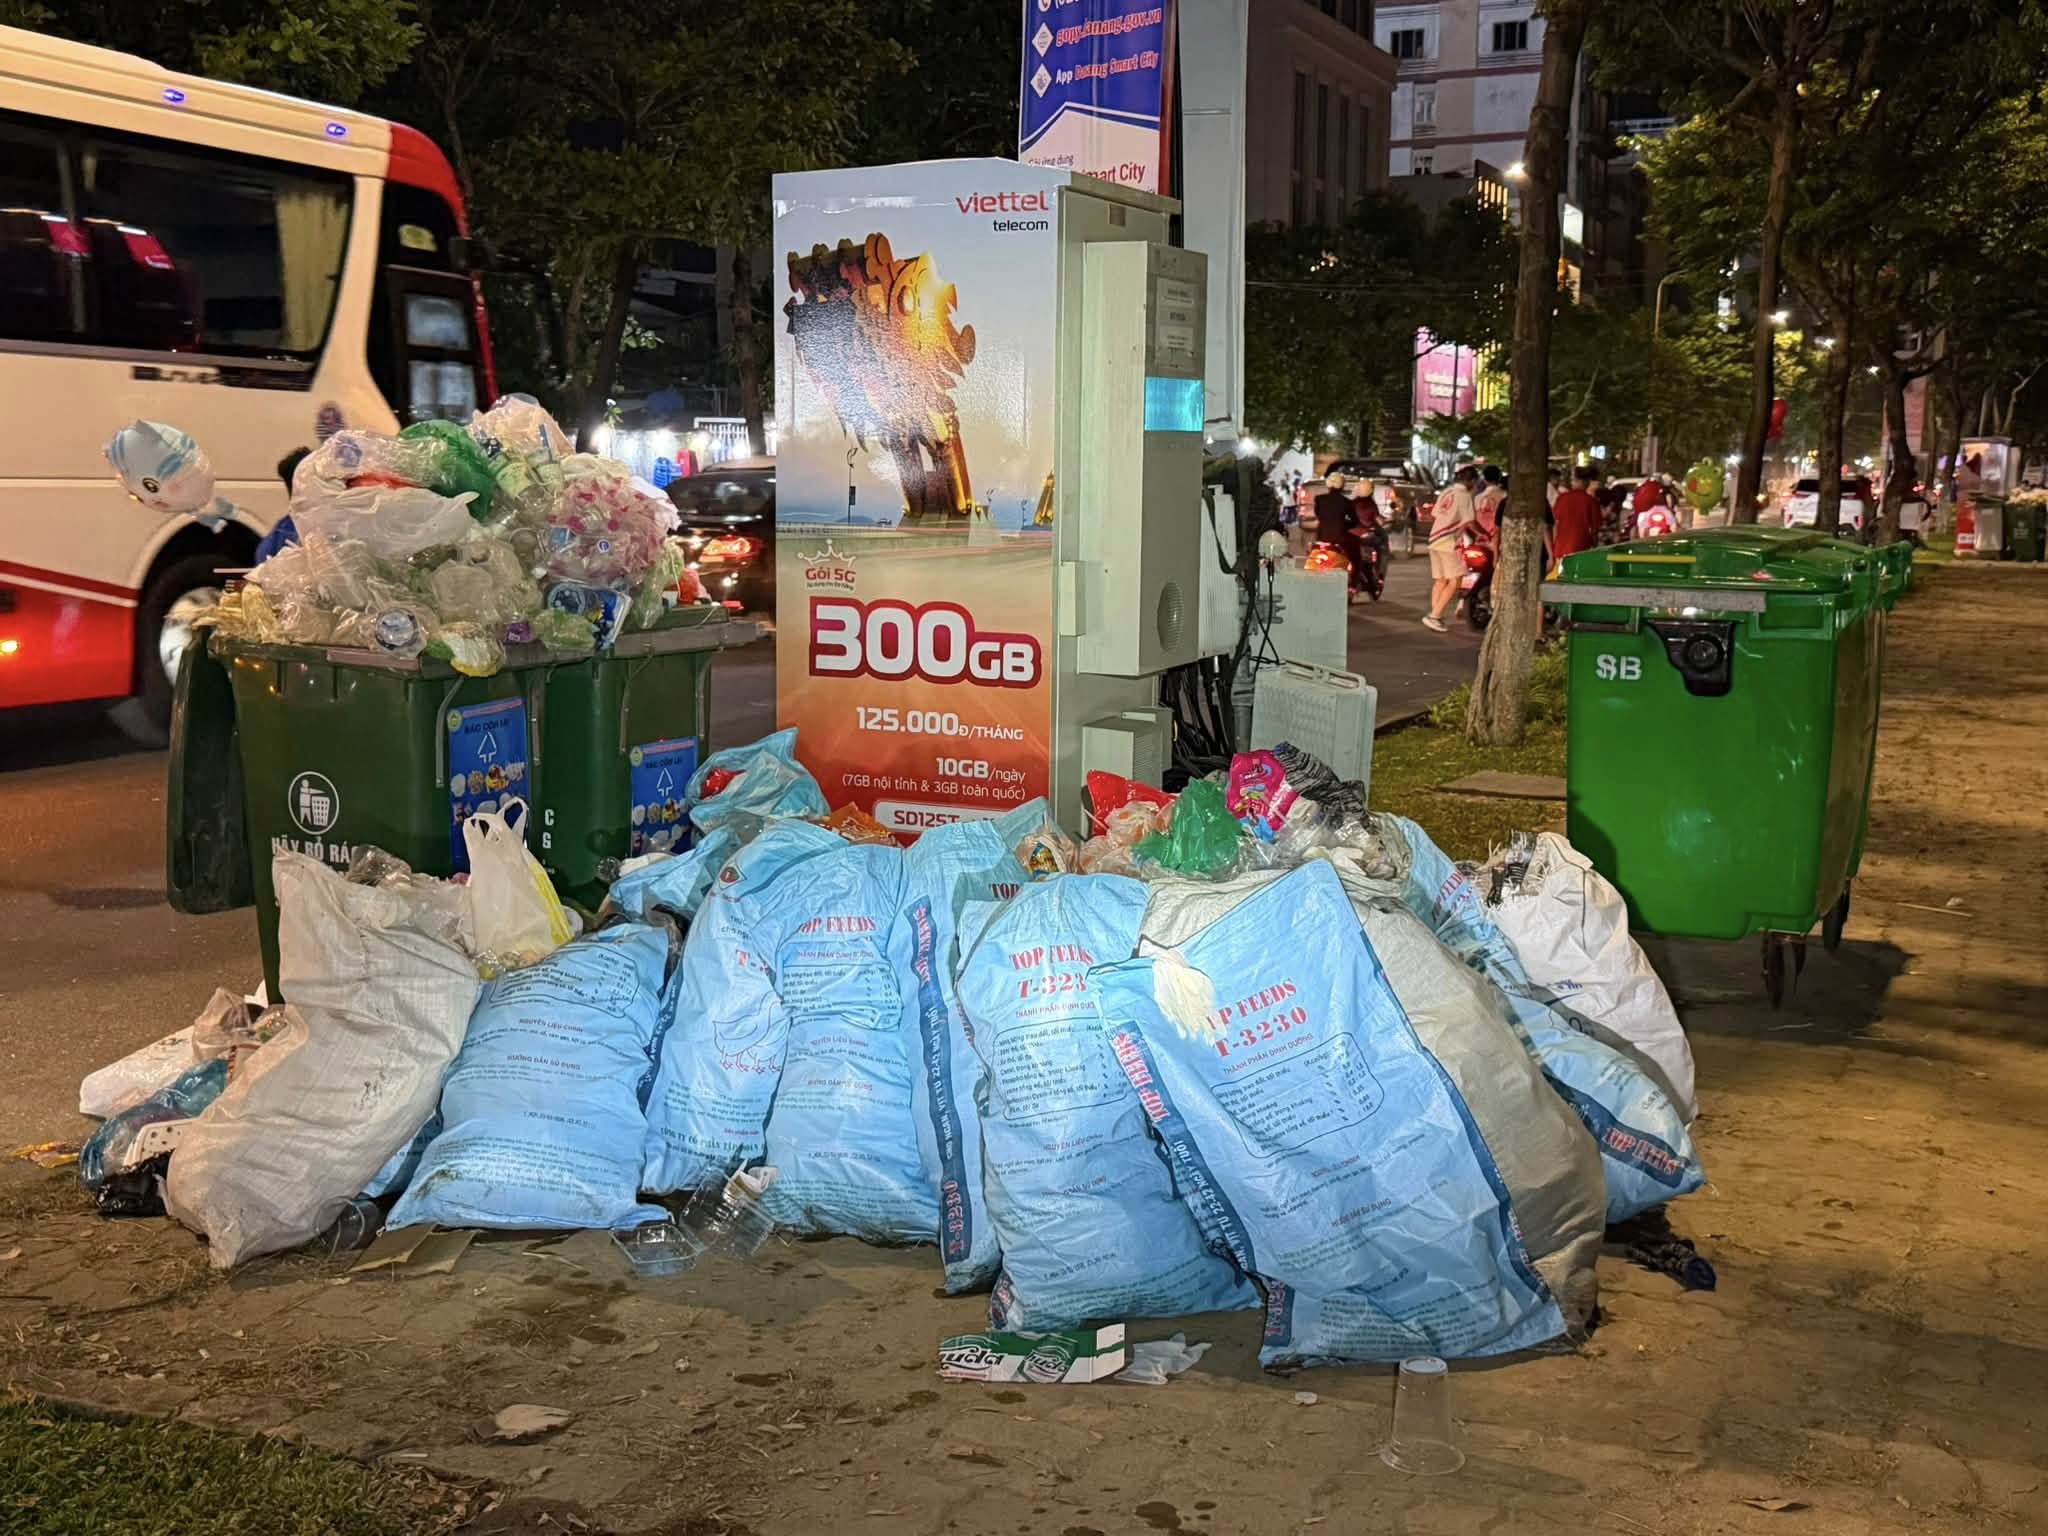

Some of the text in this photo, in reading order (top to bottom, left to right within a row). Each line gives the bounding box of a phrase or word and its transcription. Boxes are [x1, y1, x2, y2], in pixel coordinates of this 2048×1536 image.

[1056, 69, 1073, 85] App
[1119, 162, 1146, 184] City
[956, 190, 1049, 213] viettel
[993, 219, 1049, 231] telecom
[834, 568, 856, 583] 5G
[814, 604, 1035, 682] 300GB
[842, 774, 870, 787] (7GB
[873, 776, 891, 790] nội
[920, 780, 930, 793] &
[933, 781, 958, 794] 3GB
[962, 784, 989, 797] toàn
[894, 810, 960, 828] SD125T
[1009, 946, 1045, 971] TOP
[1017, 971, 1087, 999] T-323
[1236, 977, 1298, 1018] FEEDS
[1214, 1006, 1309, 1058] T-3230
[1136, 1084, 1170, 1122] TOP
[1170, 1138, 1194, 1166] TUỔI
[1185, 1163, 1209, 1191] NGÀY
[1201, 1186, 1225, 1217] 22-42
